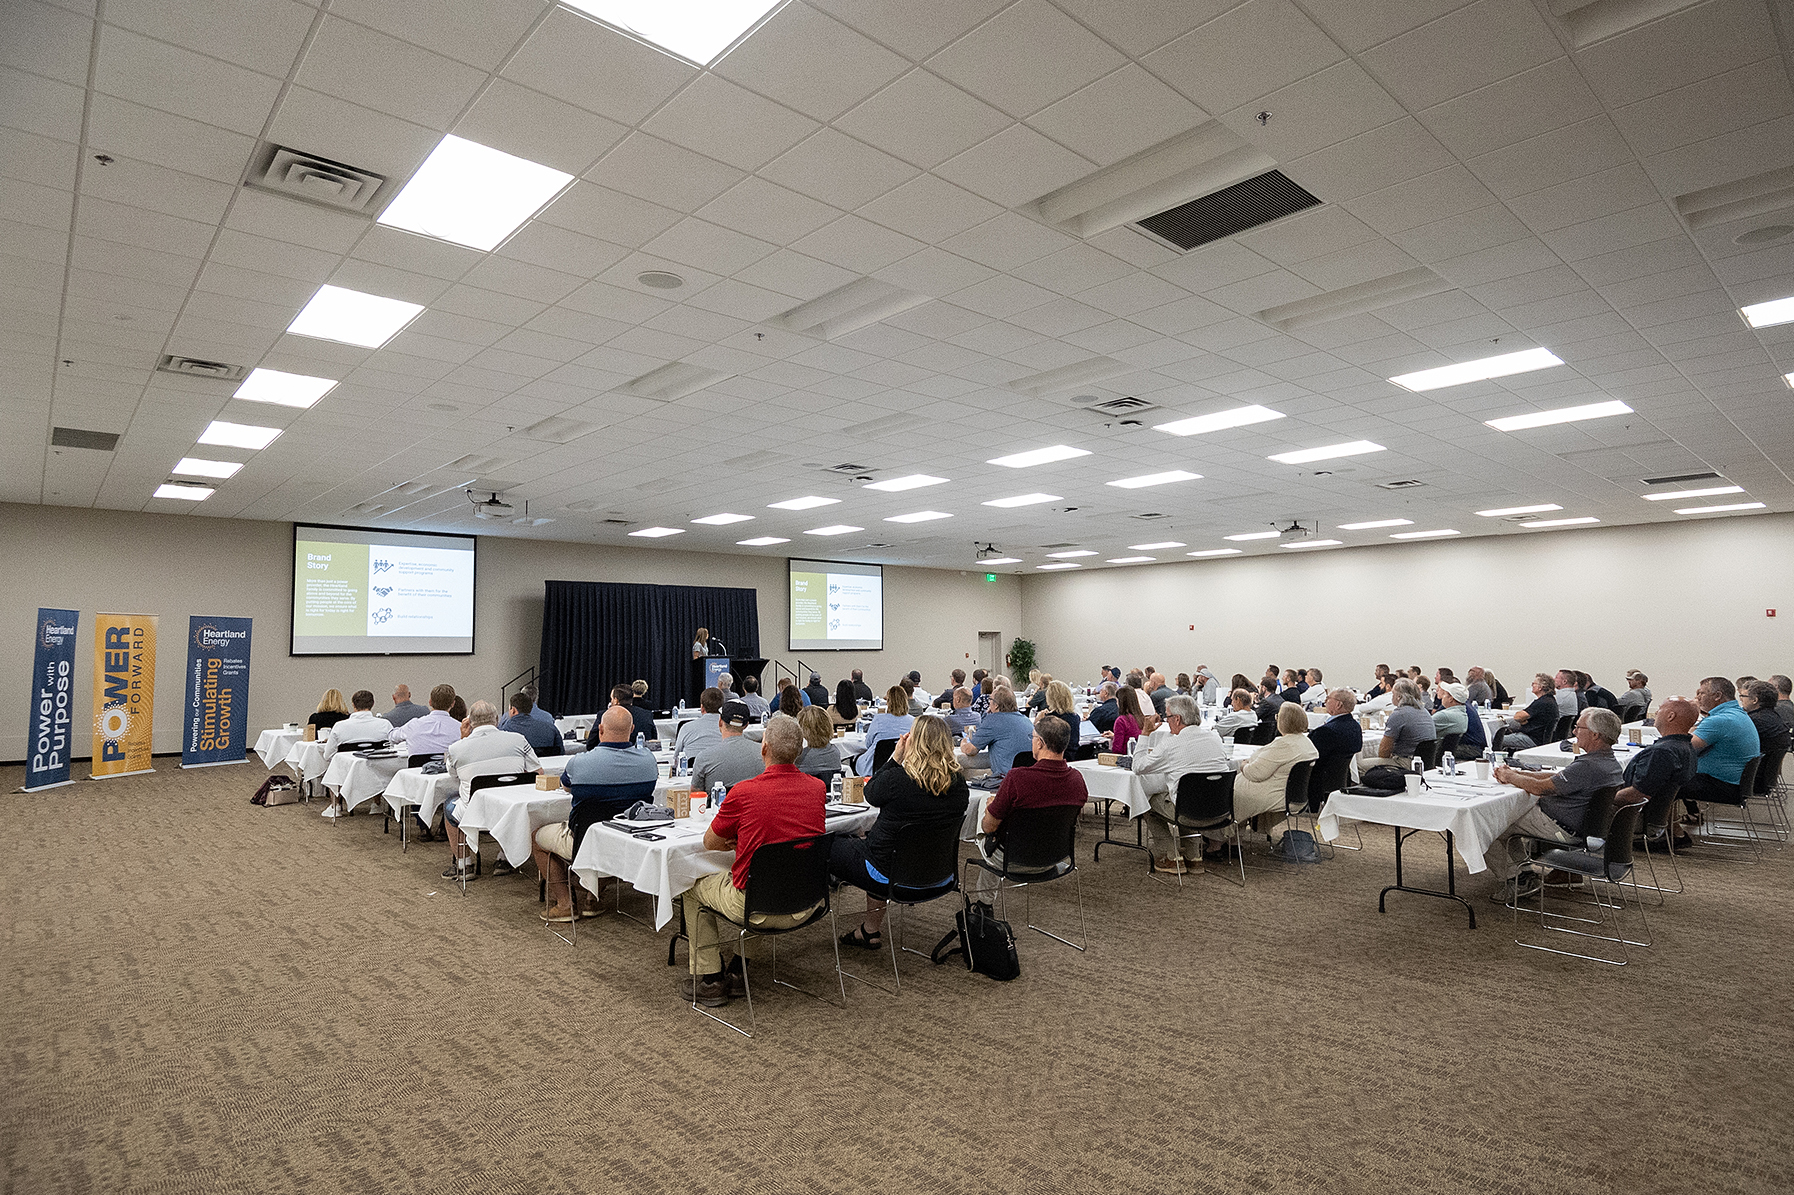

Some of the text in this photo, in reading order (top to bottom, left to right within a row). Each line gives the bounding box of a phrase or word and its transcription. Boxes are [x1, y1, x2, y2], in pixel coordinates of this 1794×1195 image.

[307, 553, 332, 561] Brand
[307, 562, 329, 571] Story
[46, 625, 74, 635] Heartland
[46, 635, 64, 645] Energy
[203, 638, 230, 647] Energy
[204, 630, 246, 638] Heartland
[130, 628, 144, 715] FORWARD
[193, 658, 202, 708] Communities
[49, 660, 70, 770] Purpose
[102, 626, 130, 762] POWER
[200, 658, 222, 751] Stimulating
[32, 688, 53, 773] Power
[190, 717, 200, 752] Powering
[216, 688, 232, 750] Growth
